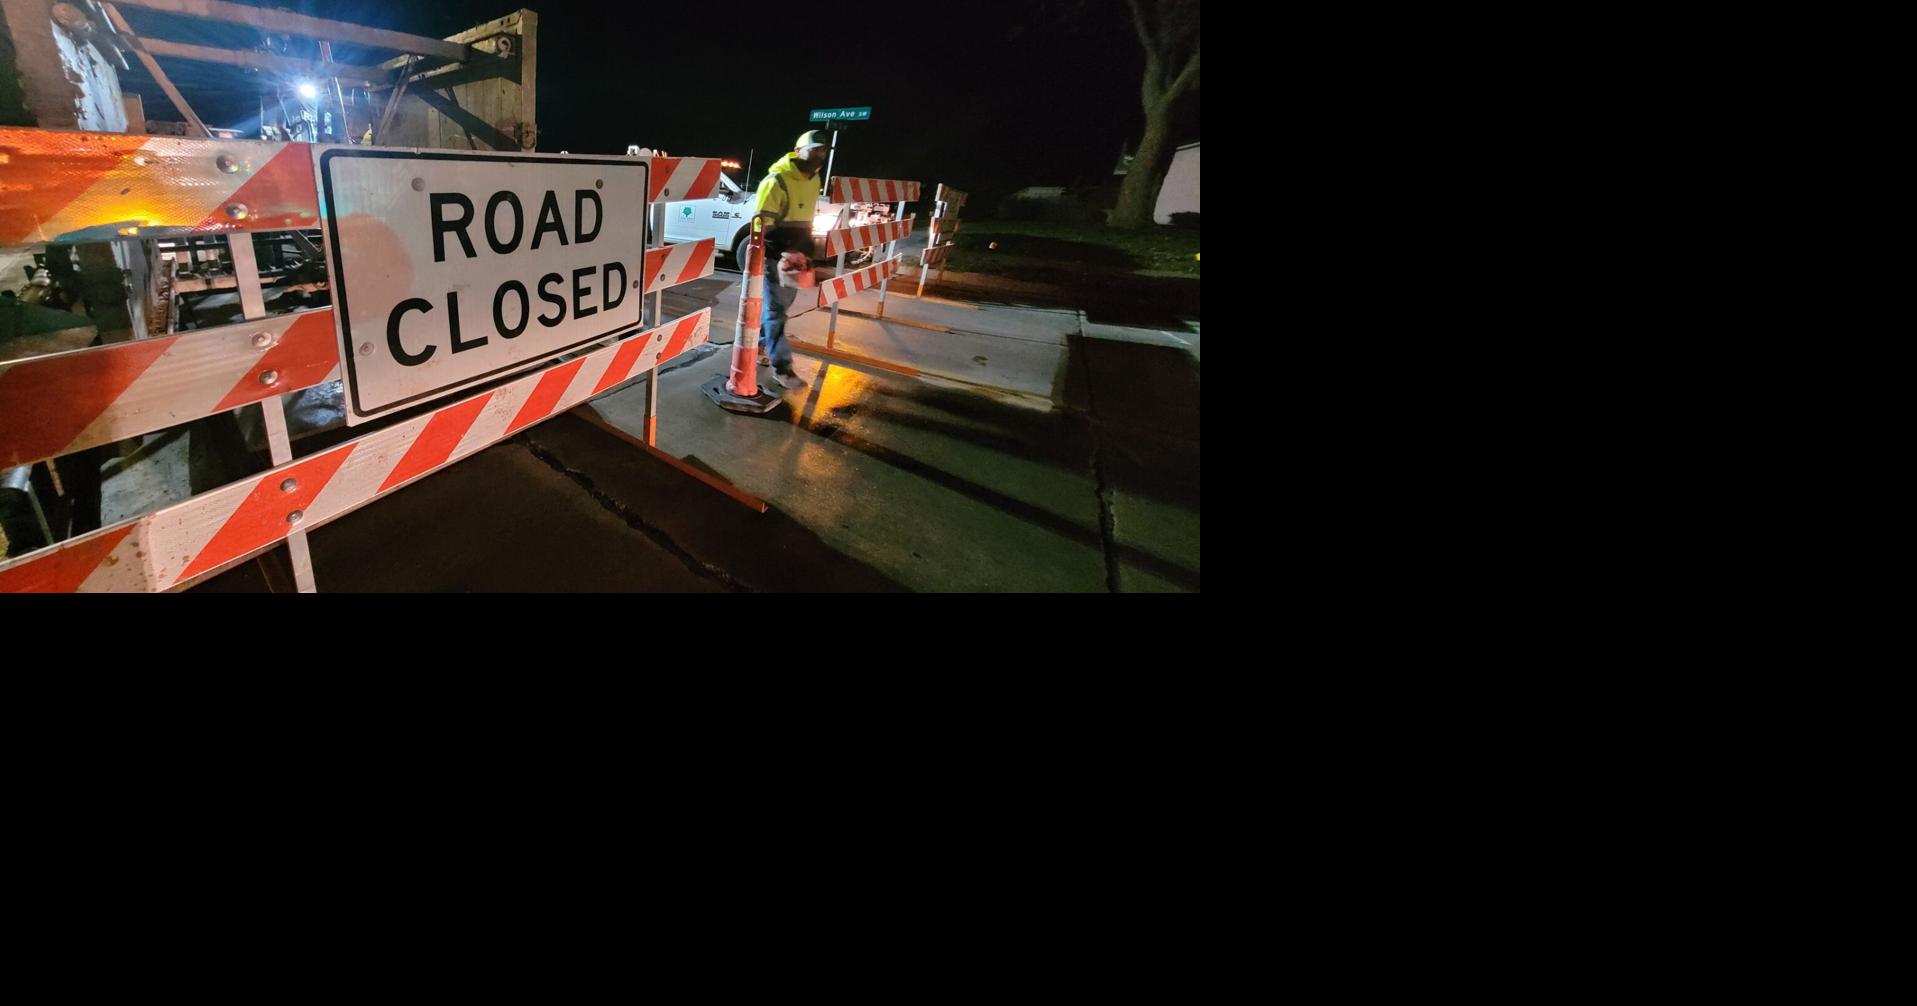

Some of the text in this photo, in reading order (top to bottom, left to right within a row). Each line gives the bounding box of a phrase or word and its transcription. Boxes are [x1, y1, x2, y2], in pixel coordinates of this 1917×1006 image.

[813, 111, 837, 119] Wilson
[839, 110, 855, 118] Ave
[430, 190, 603, 263] ROAD
[386, 262, 628, 367] CLOSED
